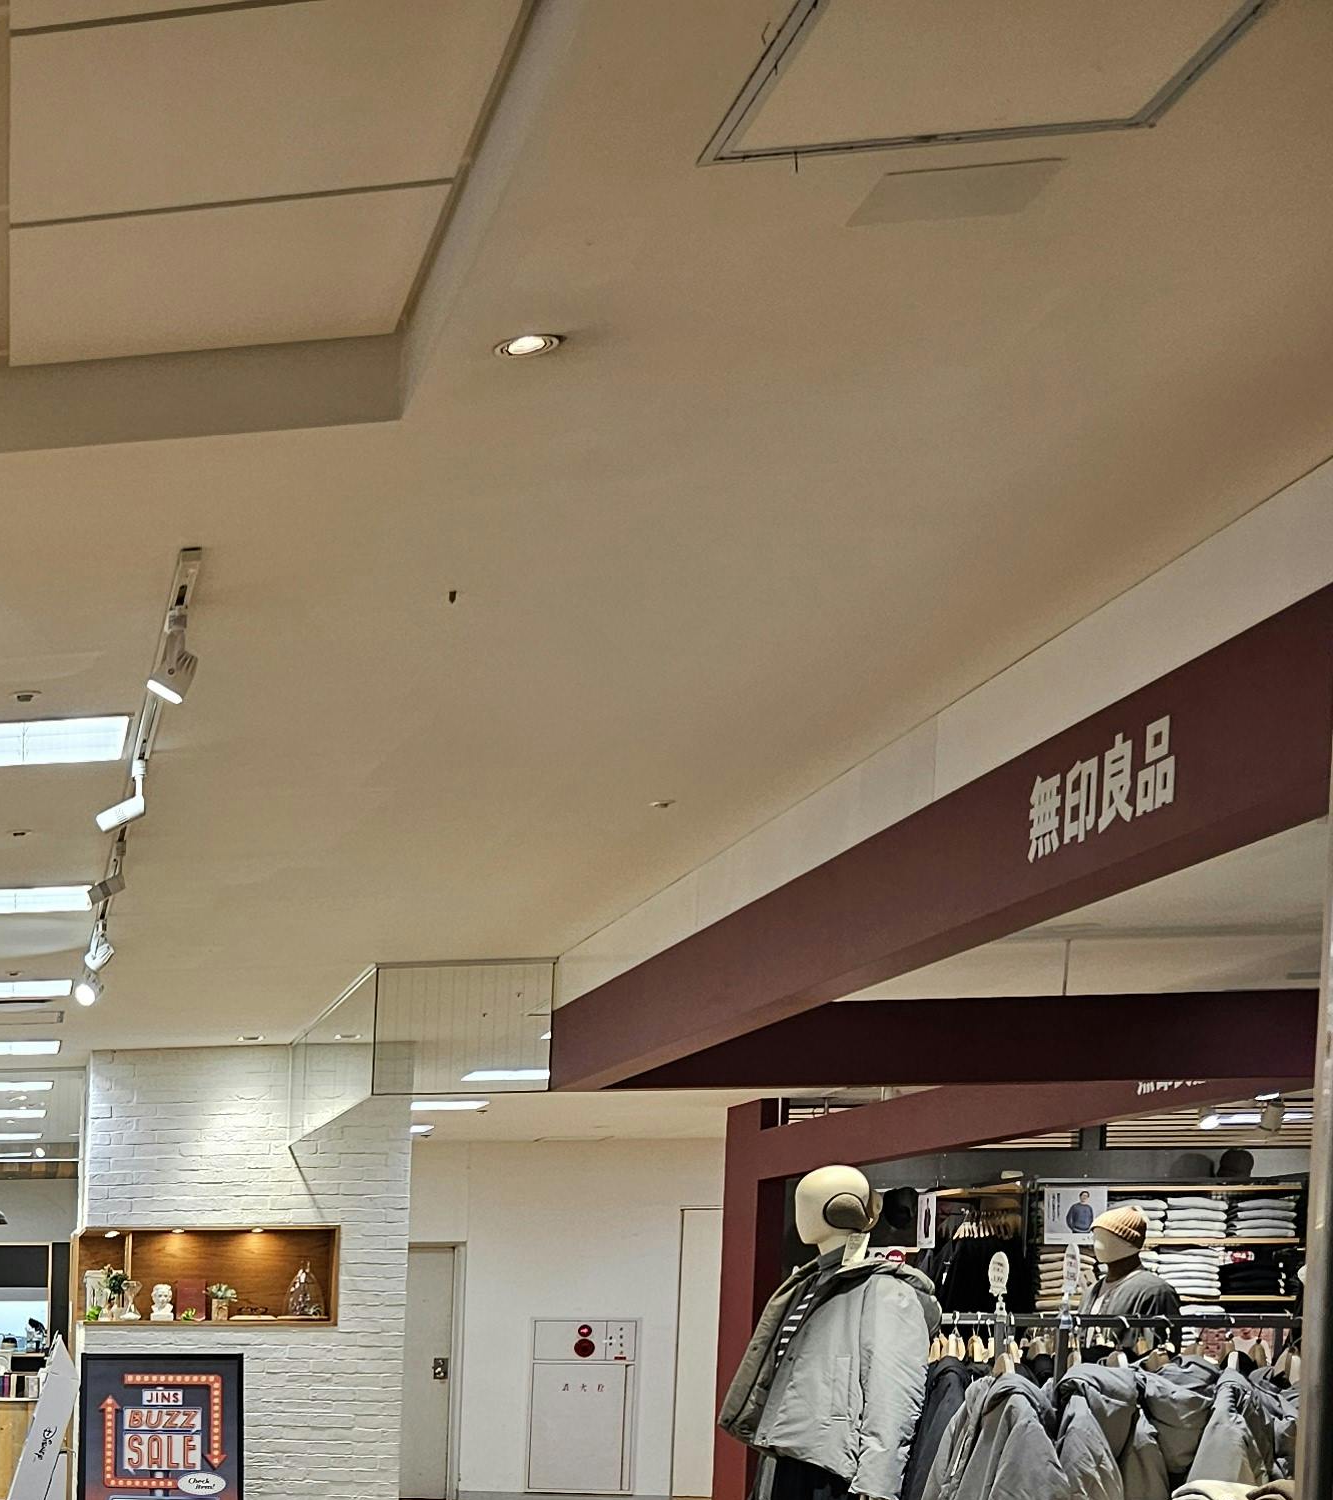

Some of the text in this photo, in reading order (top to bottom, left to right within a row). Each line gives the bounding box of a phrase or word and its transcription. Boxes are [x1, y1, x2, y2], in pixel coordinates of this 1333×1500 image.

[1027, 714, 1177, 864] 無印良品
[146, 1392, 180, 1404] JINS
[128, 1410, 198, 1429] BUZZ
[127, 1434, 197, 1469] SALE
